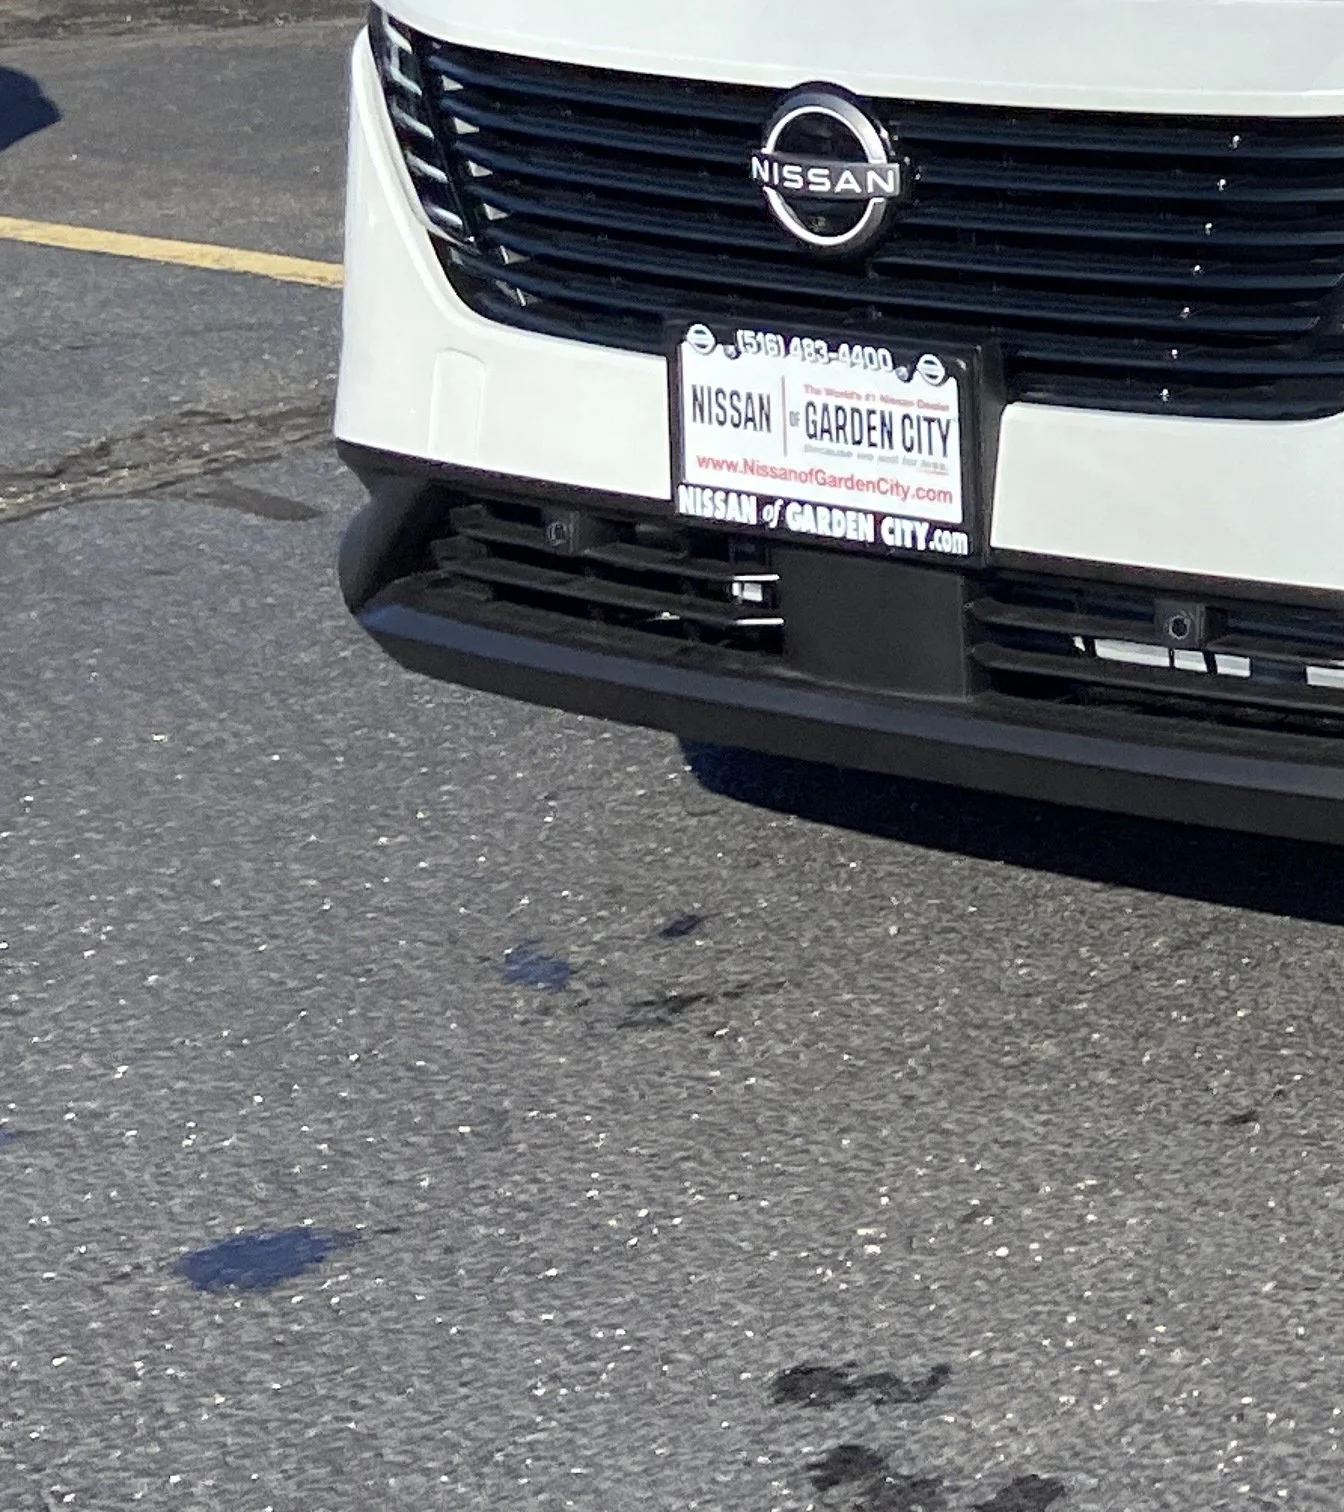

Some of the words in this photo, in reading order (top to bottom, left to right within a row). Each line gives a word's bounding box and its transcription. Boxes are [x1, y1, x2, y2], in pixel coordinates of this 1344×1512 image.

[751, 156, 895, 194] NISSAN
[736, 329, 786, 359] (516)
[789, 335, 894, 372] 483-4400
[692, 384, 772, 433] NISSAN
[805, 401, 895, 451] GARDEN
[902, 414, 951, 458] CITY
[696, 454, 953, 505] www.NissanofGardenCity.com
[678, 484, 757, 526] NISSAN
[762, 498, 785, 529] of
[785, 501, 875, 543] GARDEN
[881, 516, 969, 556] CITY.com
